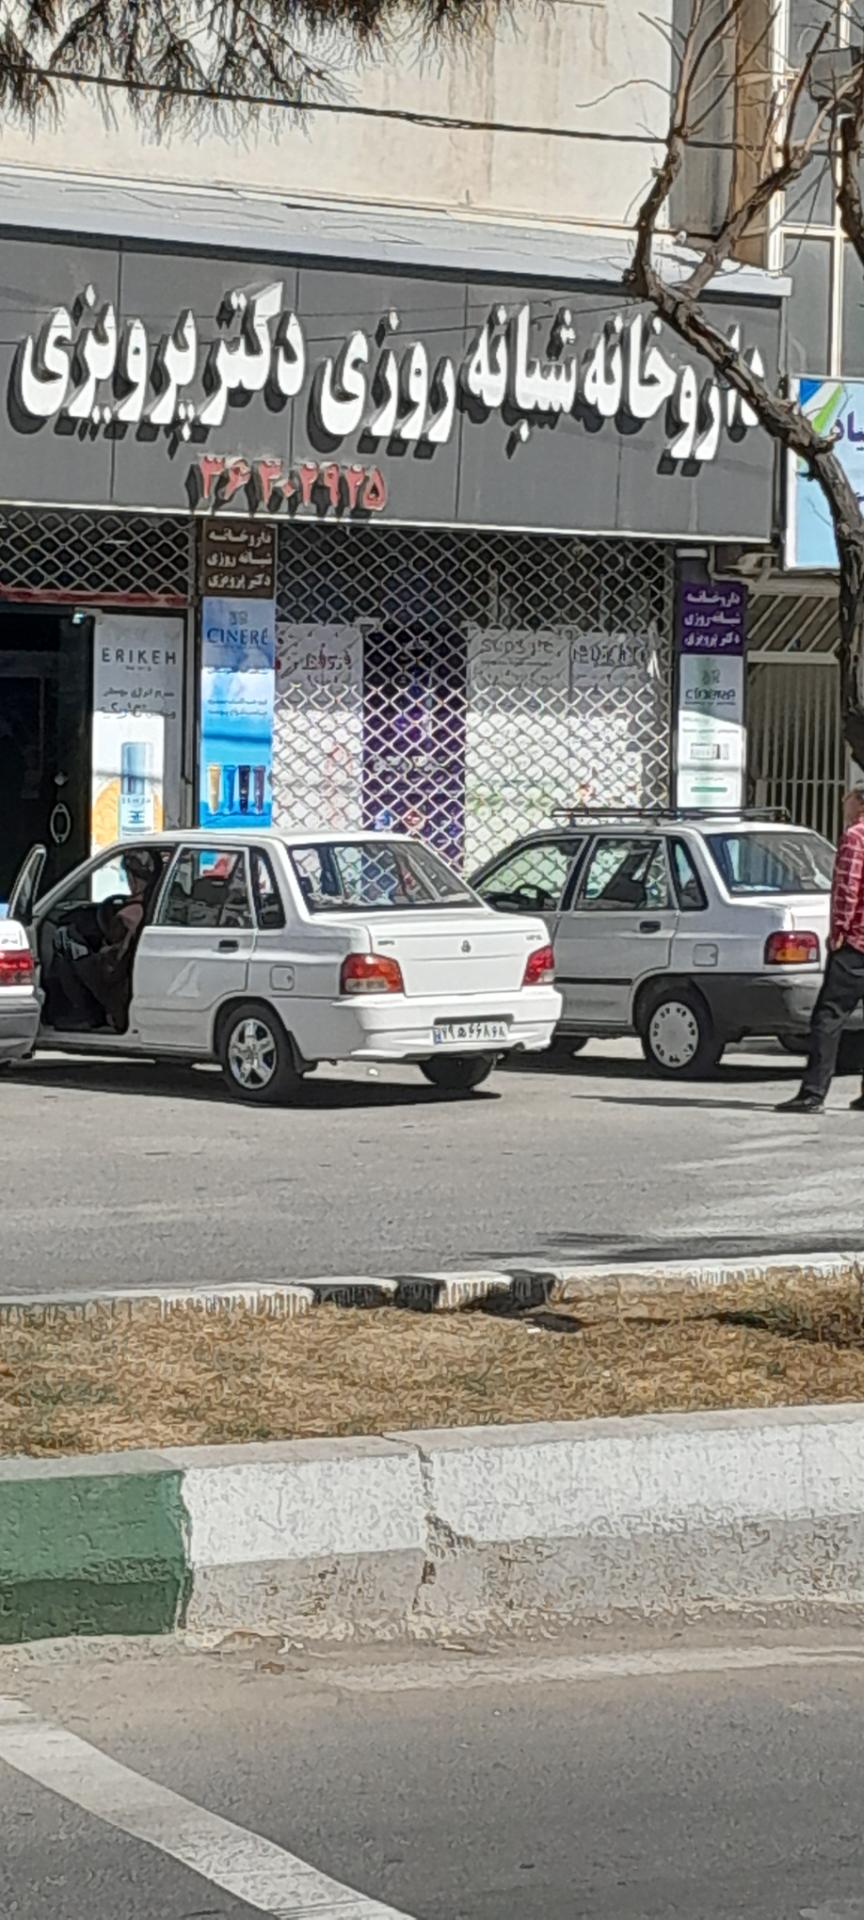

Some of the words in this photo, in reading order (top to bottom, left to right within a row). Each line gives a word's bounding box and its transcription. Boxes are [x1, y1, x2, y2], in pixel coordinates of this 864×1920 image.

[21, 283, 197, 442] پرویزی
[200, 281, 305, 427] دکتر
[319, 307, 456, 443] روزی
[467, 304, 577, 443] شبانه
[584, 312, 765, 460] داروخانه
[208, 529, 272, 548] داروخانه
[206, 552, 237, 568] روزی
[238, 550, 273, 568] شبانه
[207, 571, 246, 590] پرویزی
[247, 572, 272, 590] دکتر
[686, 589, 741, 608] داروخانه
[684, 612, 712, 627] روزی
[711, 610, 742, 627] شبانه
[684, 631, 719, 648] پرویزی
[719, 631, 741, 646] دکتر
[101, 647, 177, 665] ERIKEH
